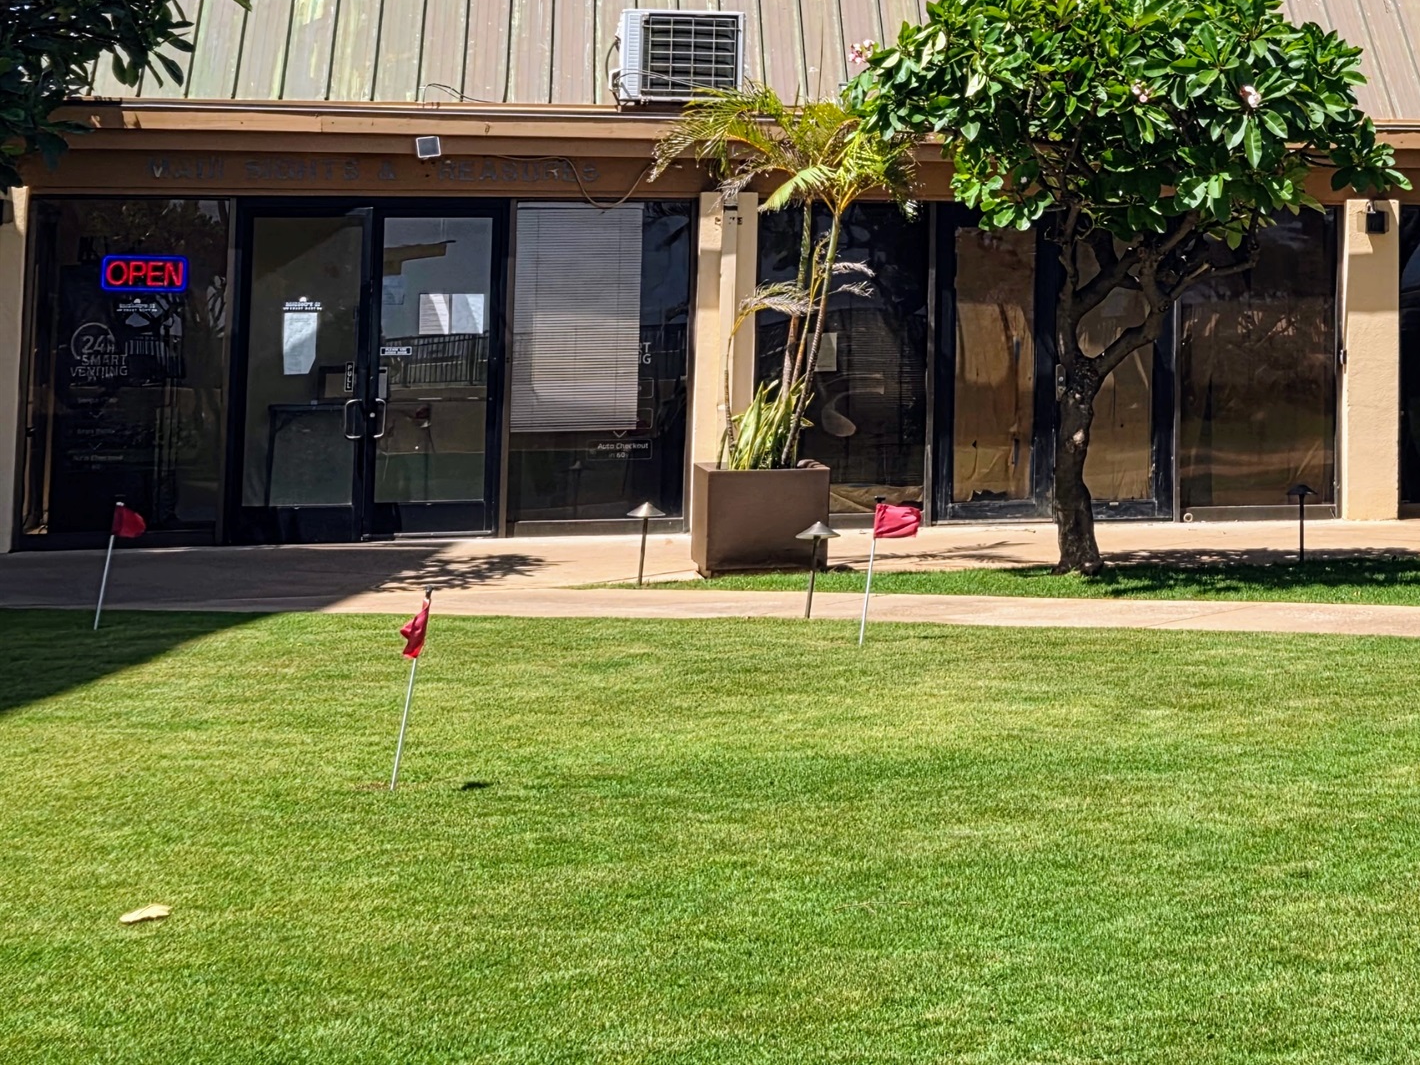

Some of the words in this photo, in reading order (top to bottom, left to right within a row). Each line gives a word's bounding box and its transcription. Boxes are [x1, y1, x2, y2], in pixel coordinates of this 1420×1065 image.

[438, 160, 600, 182] REASURES
[105, 260, 184, 287] OPEN
[82, 354, 127, 366] SMART
[70, 366, 129, 377] VENDING
[616, 442, 649, 450] Checkout
